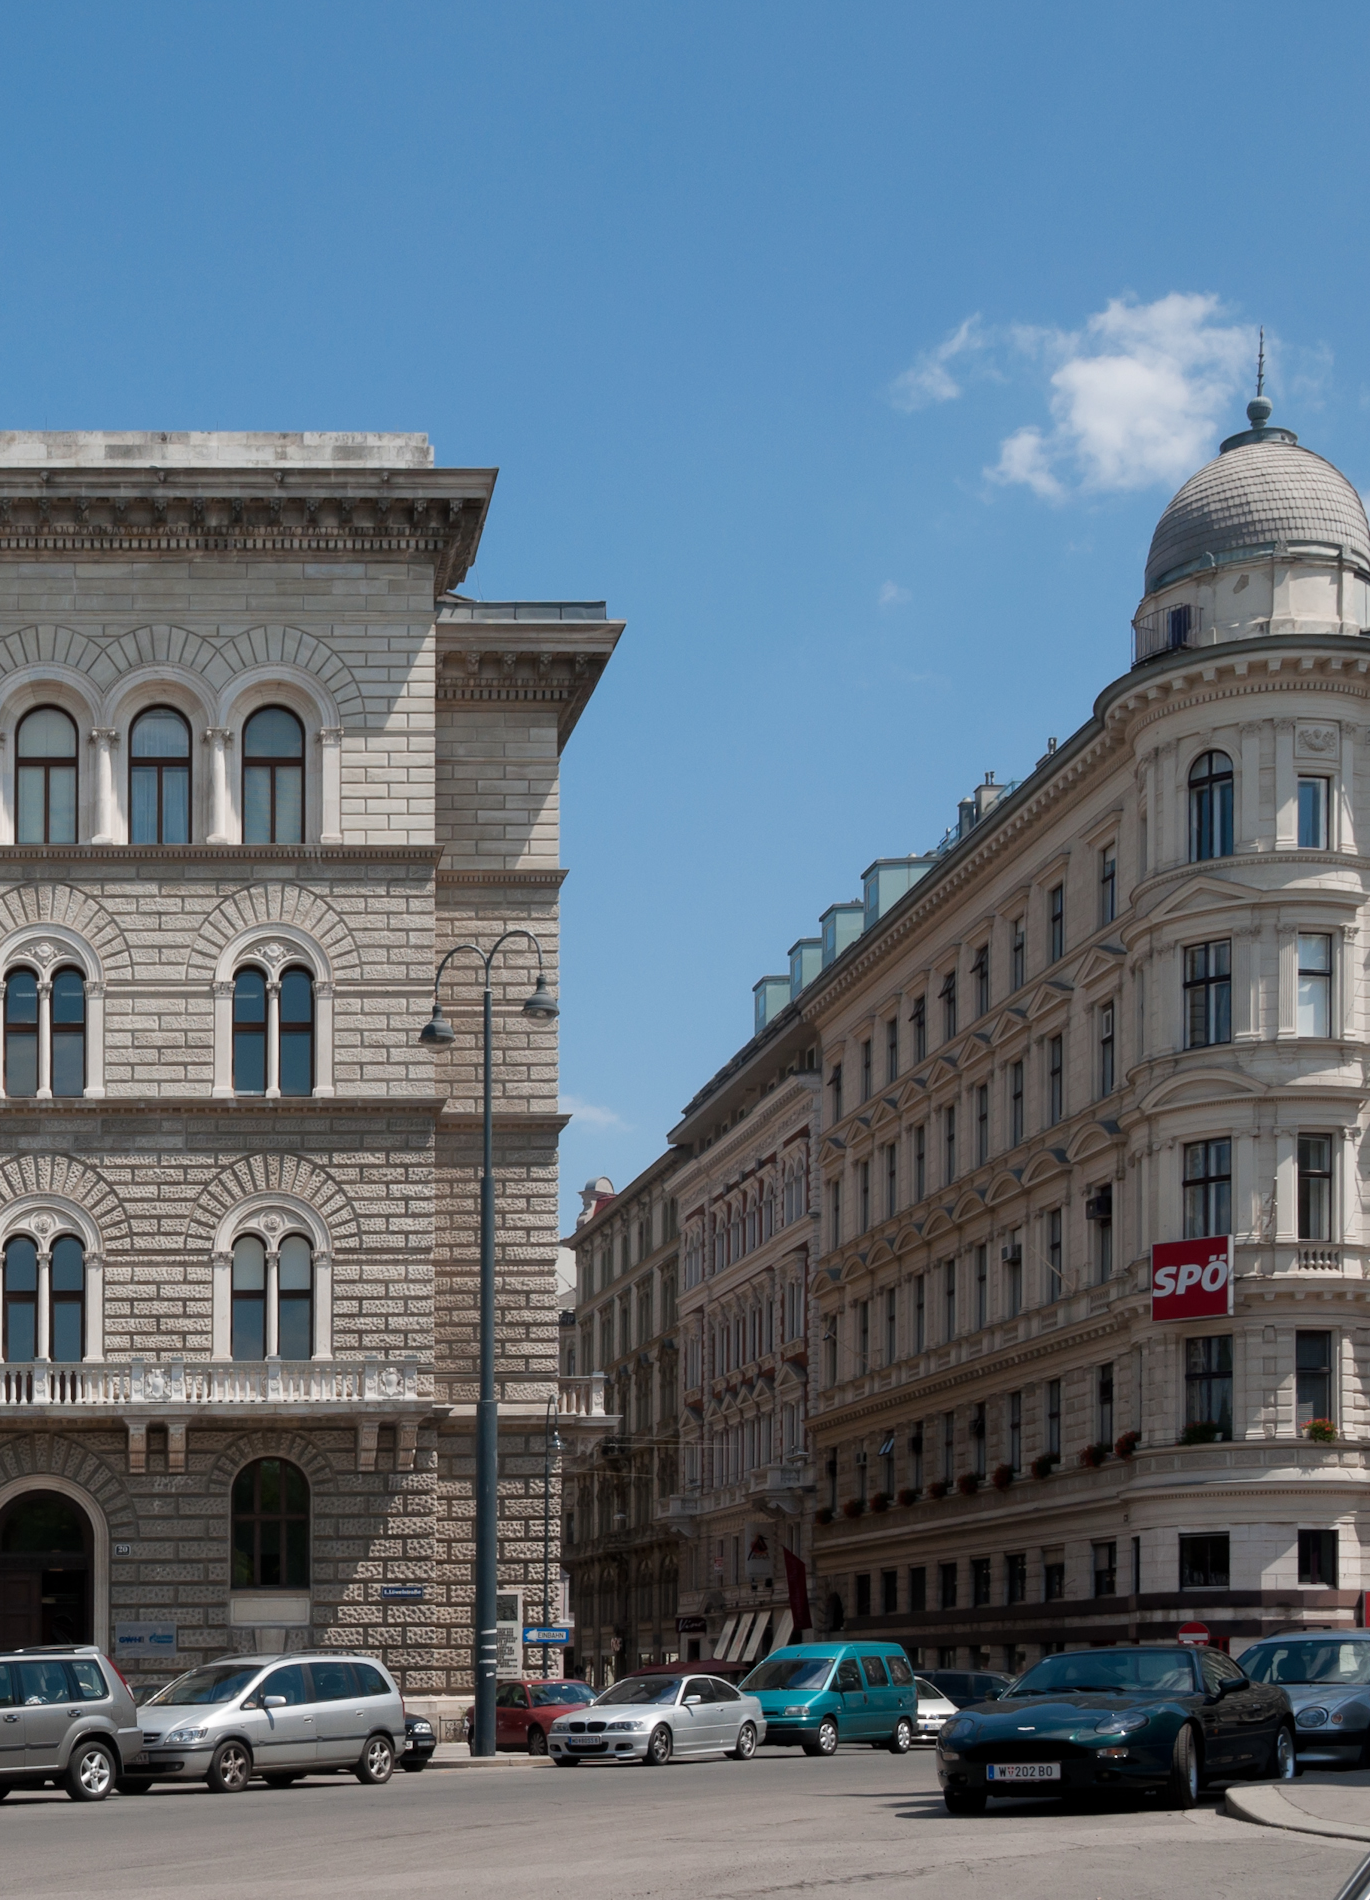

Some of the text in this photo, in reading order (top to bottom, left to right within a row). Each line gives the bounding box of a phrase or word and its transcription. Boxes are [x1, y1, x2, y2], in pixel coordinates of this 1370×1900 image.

[1152, 1253, 1228, 1297] SPÖ
[117, 1545, 128, 1553] 20
[998, 1766, 1007, 1778] W
[1015, 1766, 1036, 1777] 202
